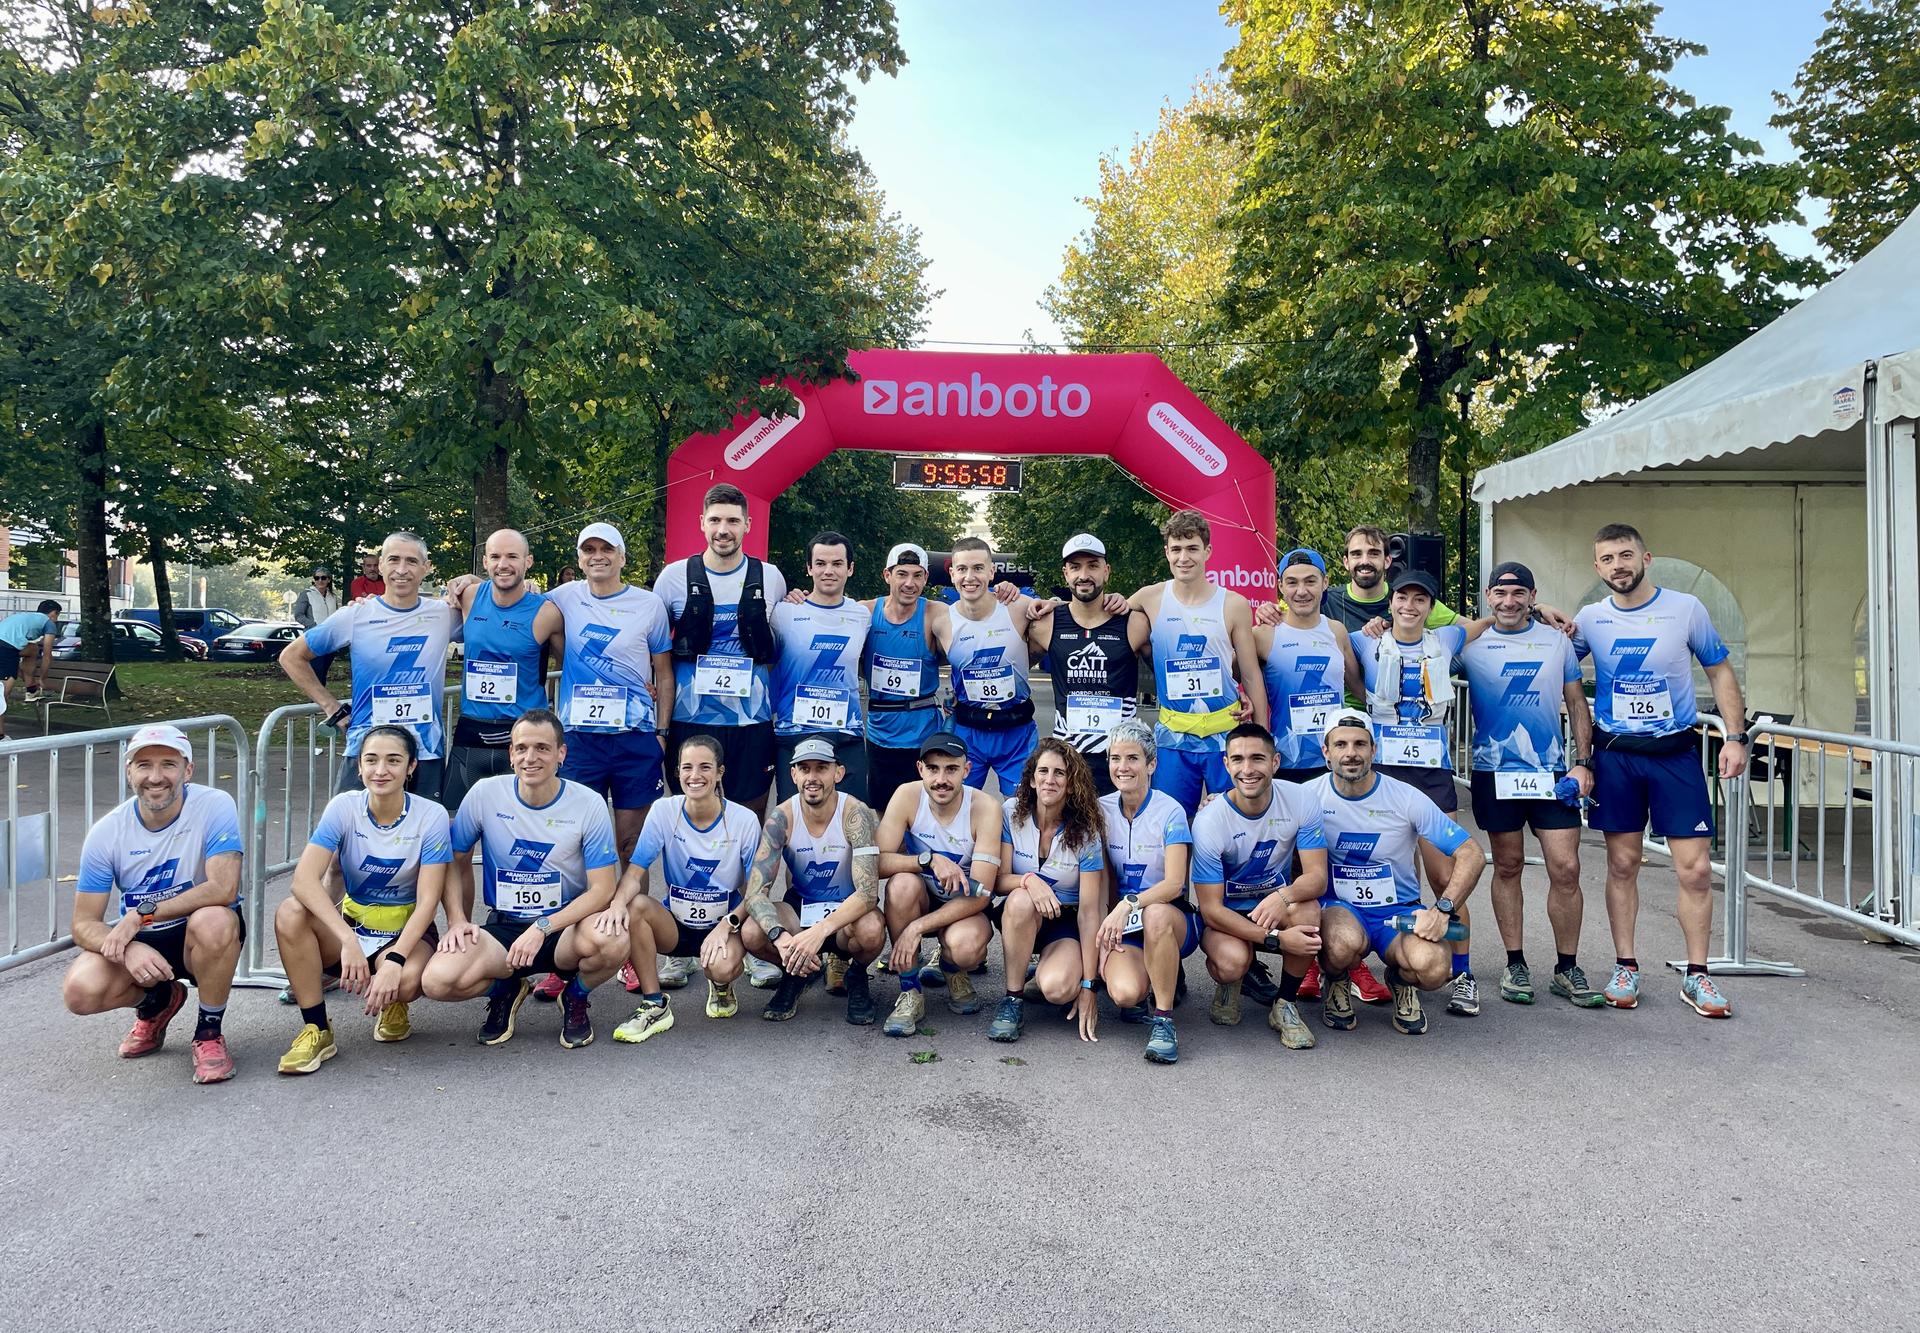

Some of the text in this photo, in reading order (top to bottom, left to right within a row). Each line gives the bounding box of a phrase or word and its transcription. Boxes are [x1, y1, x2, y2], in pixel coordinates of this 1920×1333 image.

[903, 371, 1091, 418] anboto
[1156, 410, 1220, 470] www.anboto.org
[924, 463, 1006, 485] 9:56:58
[1205, 565, 1276, 588] anboto
[1612, 647, 1649, 655] ZORNOTZA
[1067, 656, 1108, 670] CATT
[1067, 670, 1108, 678] MORKAIKO
[480, 681, 495, 694] 82
[715, 675, 731, 688] 42
[887, 676, 902, 688] 69
[1188, 678, 1201, 691] 31
[983, 685, 998, 696] 88
[395, 704, 412, 717] 87
[589, 705, 605, 718] 27
[811, 706, 831, 719] 101
[1630, 702, 1654, 714] 126
[1087, 714, 1100, 727] 19
[1312, 712, 1326, 725] 47
[1403, 745, 1420, 758] 45
[1514, 778, 1537, 790] 144
[1338, 842, 1373, 850] ZORNOTZA
[362, 863, 398, 874] ZORNOTZA
[515, 891, 541, 904] 150
[1356, 887, 1374, 900] 36
[690, 908, 707, 919] 28
[824, 909, 836, 918] 2
